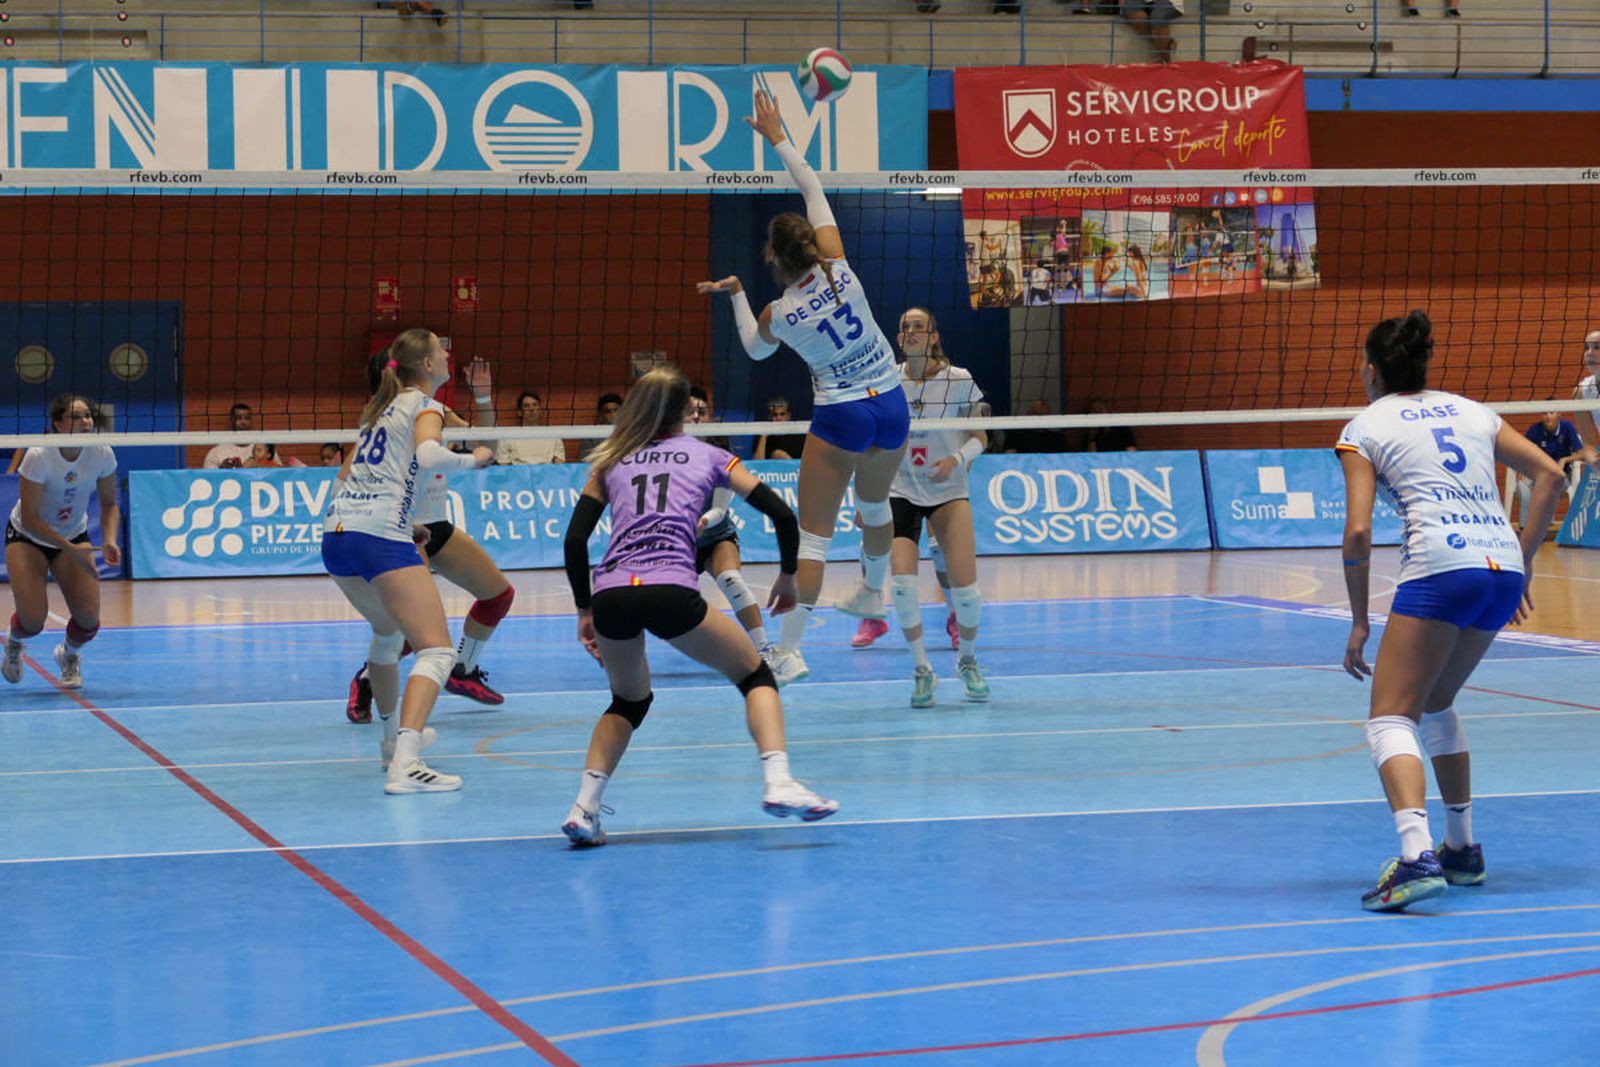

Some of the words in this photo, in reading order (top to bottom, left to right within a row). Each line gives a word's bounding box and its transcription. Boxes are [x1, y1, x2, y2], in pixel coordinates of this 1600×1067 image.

[1067, 86, 1260, 117] SERVIGROUP
[1068, 126, 1175, 146] HOTELES
[130, 171, 202, 184] rfevb.com
[326, 172, 397, 185] rfevb.com
[519, 173, 588, 186] rfevb.com
[706, 173, 774, 185] rfevb.com
[889, 173, 955, 185] rfevb.com
[1067, 172, 1133, 184] rfevb.com
[1243, 171, 1306, 183] rfevb.com
[1414, 170, 1477, 182] rfevb.com
[785, 306, 808, 327] DE
[808, 271, 852, 312] DIEGO
[816, 301, 864, 350] 13
[1400, 404, 1459, 421] GASE
[353, 426, 388, 465] 28
[1431, 427, 1467, 474] 5
[631, 473, 670, 515] 11
[988, 467, 1174, 515] ODIN
[1231, 499, 1288, 520] Suma
[484, 515, 612, 541] ALICN
